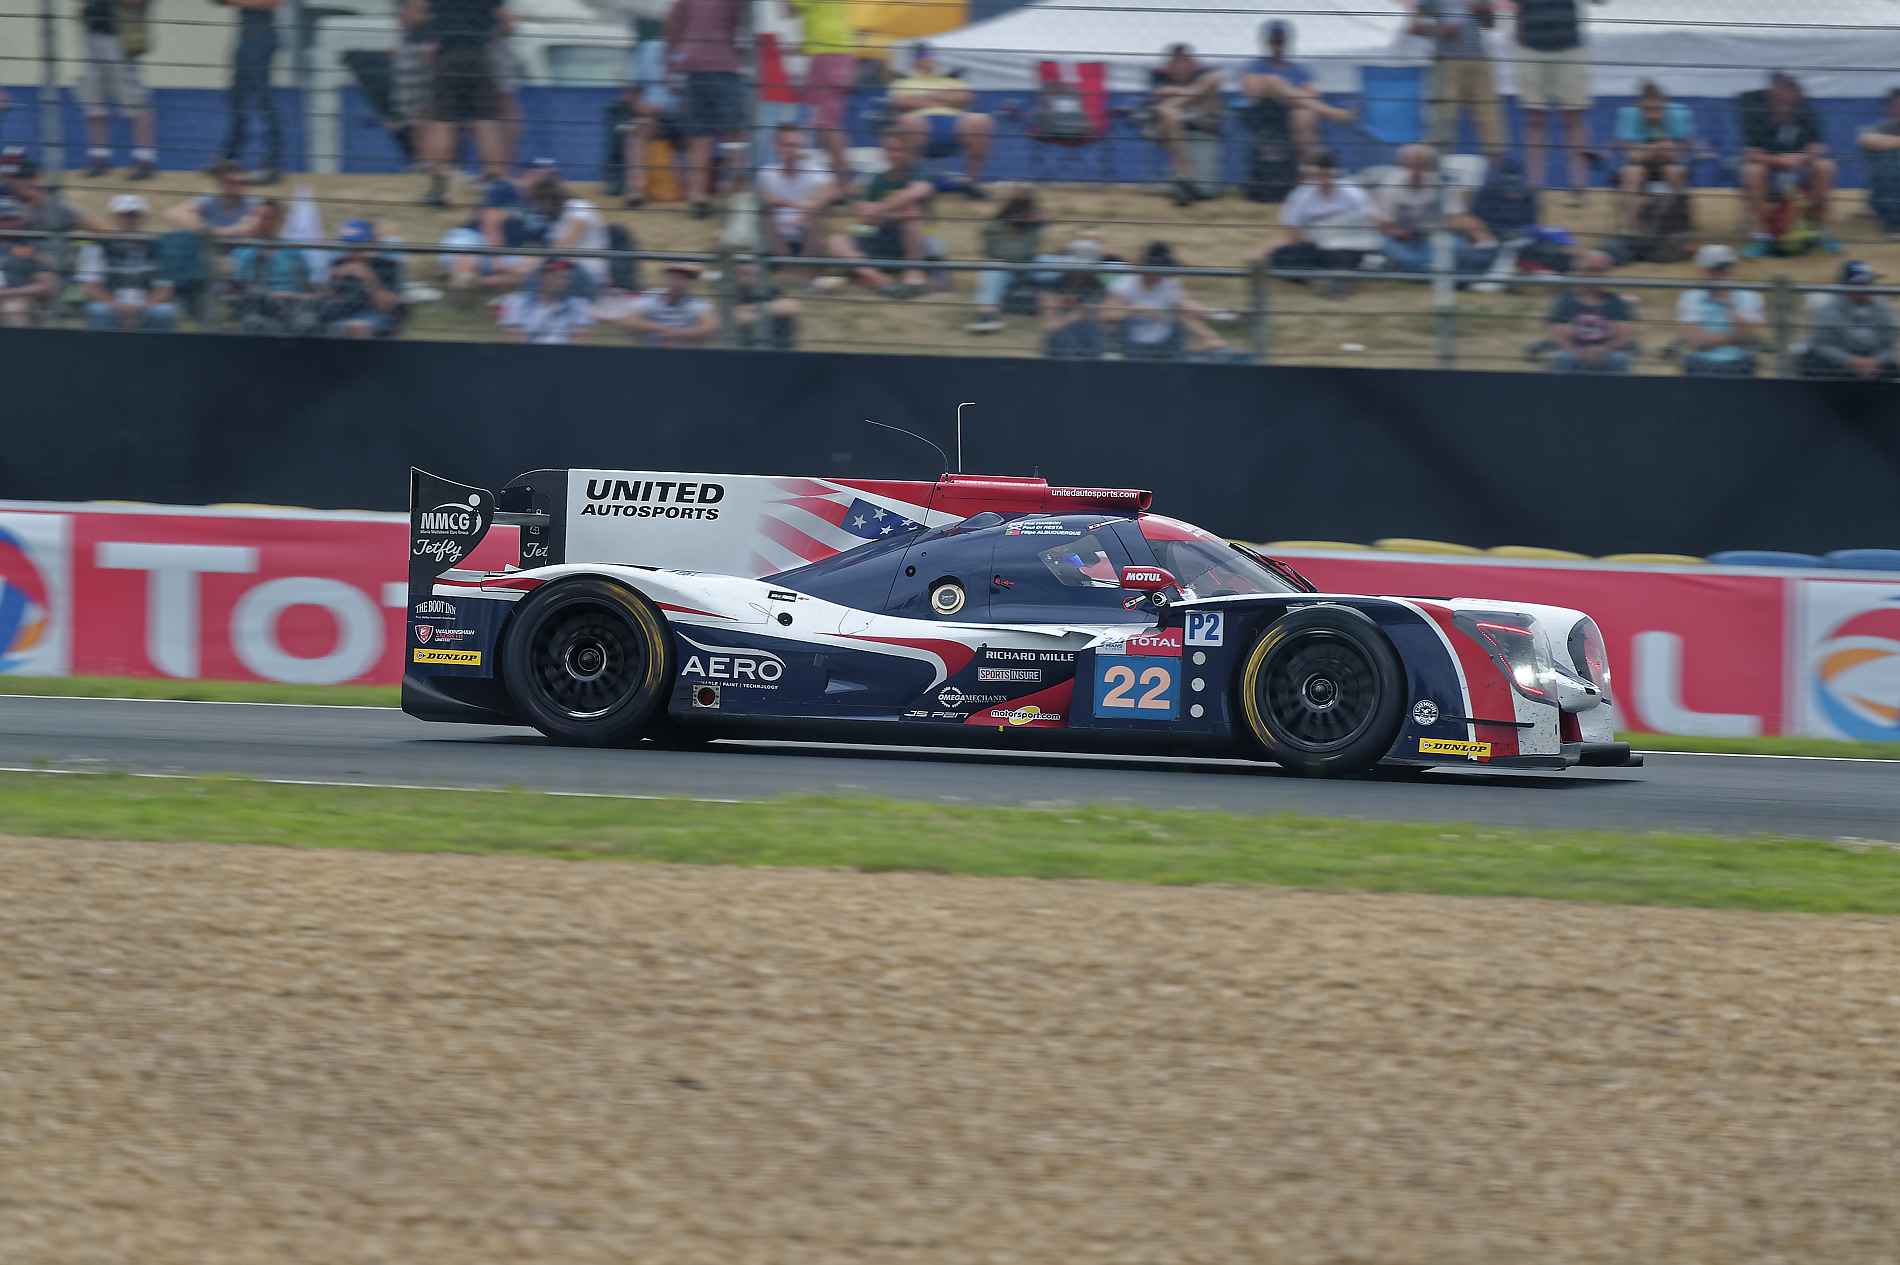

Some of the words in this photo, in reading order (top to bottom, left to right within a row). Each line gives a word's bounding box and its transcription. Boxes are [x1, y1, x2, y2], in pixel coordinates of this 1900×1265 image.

[586, 479, 725, 504] UNITED
[1051, 489, 1137, 499] unitedautosports.com
[581, 503, 719, 520] AUTOSPORTS
[420, 512, 470, 530] MMCG
[413, 539, 462, 562] Jetfly
[1125, 572, 1162, 582] MOTUL
[416, 601, 428, 613] THE
[428, 600, 446, 613] BOOT
[445, 602, 456, 615] INN
[1189, 613, 1220, 641] P2
[426, 653, 477, 662] DUNLOP
[985, 651, 1036, 661] RICHARD
[1039, 653, 1074, 662] MILLE
[681, 655, 783, 681] AERO
[980, 669, 1010, 680] SPORTS
[1010, 670, 1040, 680] INSURE
[1102, 665, 1171, 710] 22
[991, 709, 1060, 721] motorsport.com
[1433, 743, 1488, 752] DUNLOP
